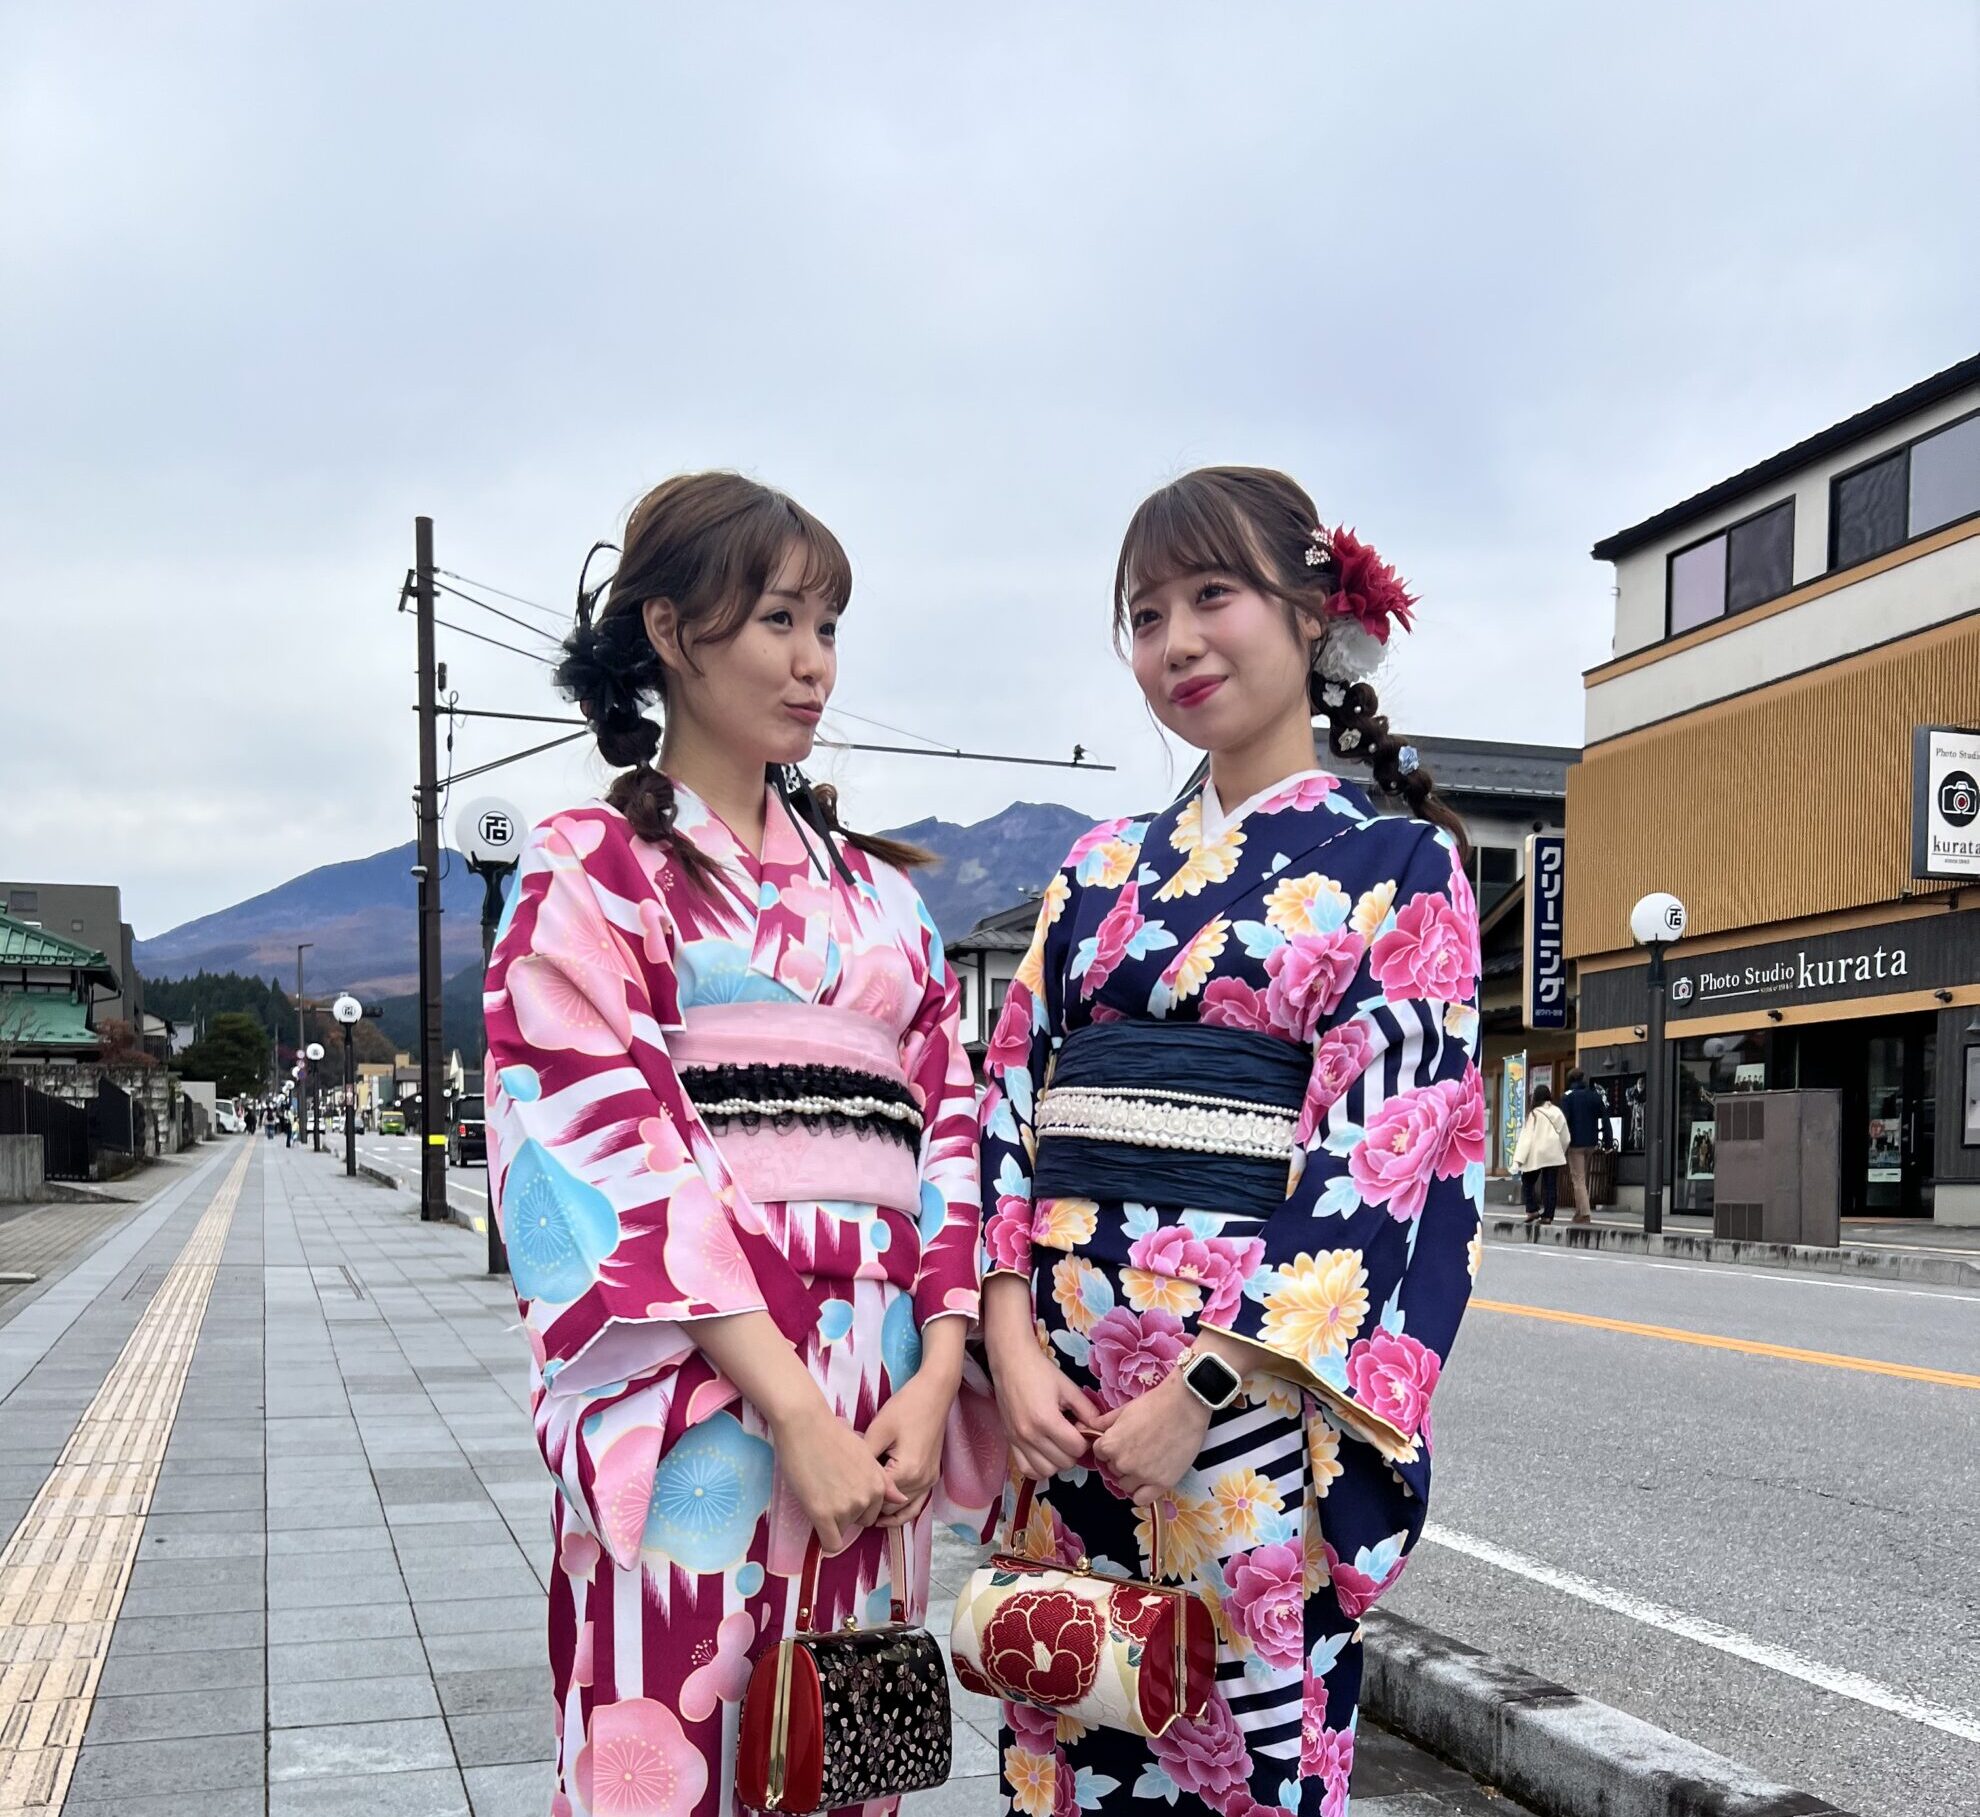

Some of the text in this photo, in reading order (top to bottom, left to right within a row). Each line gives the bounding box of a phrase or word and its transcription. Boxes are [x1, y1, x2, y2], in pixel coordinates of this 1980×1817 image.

[1936, 747, 1957, 758] Photo
[1933, 834, 1980, 855] kurata
[1539, 846, 1565, 1003] クリーニング
[1699, 973, 1740, 992] Photo
[1744, 963, 1795, 986] Studio
[1797, 945, 1908, 989] kurata
